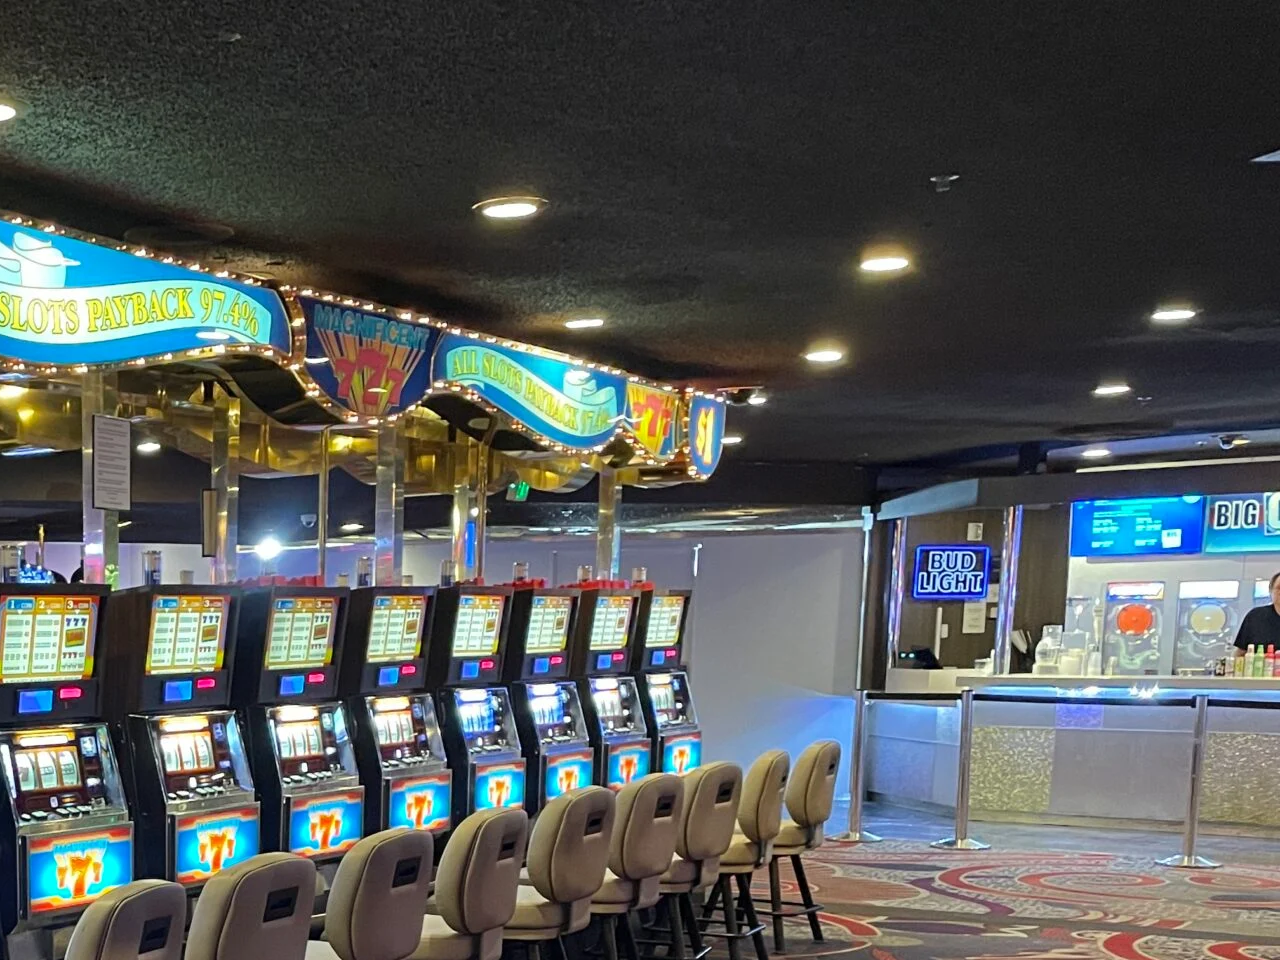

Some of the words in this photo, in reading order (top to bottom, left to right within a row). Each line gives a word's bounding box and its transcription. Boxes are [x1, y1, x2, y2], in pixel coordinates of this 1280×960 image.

[86, 287, 195, 333] PAYBACK
[199, 287, 260, 338] 97.4%
[334, 348, 406, 407] 777
[452, 350, 480, 377] ALL
[482, 352, 523, 394] SLOTS
[1213, 499, 1260, 530] BIG
[927, 550, 977, 572] BUD
